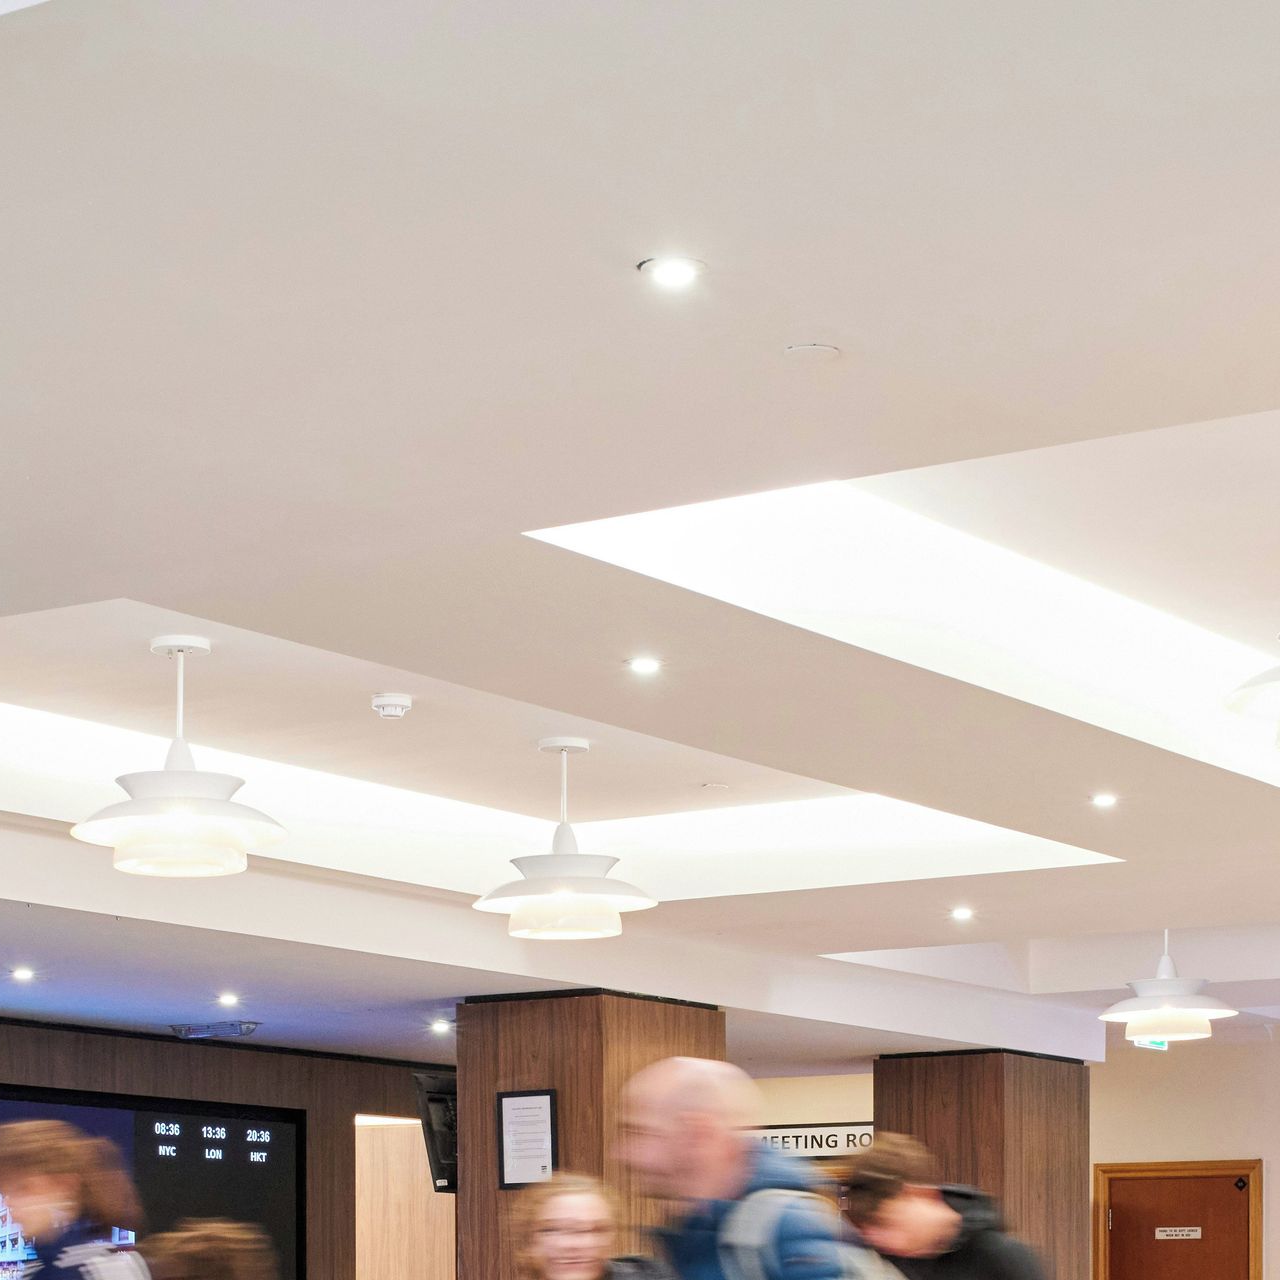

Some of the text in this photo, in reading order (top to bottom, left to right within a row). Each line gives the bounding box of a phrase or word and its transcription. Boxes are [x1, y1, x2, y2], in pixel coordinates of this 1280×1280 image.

[154, 1122, 180, 1136] 08:36
[202, 1126, 226, 1139] 13:36
[246, 1129, 271, 1142] 20:36
[846, 1132, 873, 1148] RO
[158, 1145, 177, 1156] NYC
[205, 1149, 222, 1160] LON
[250, 1151, 268, 1162] HKT
